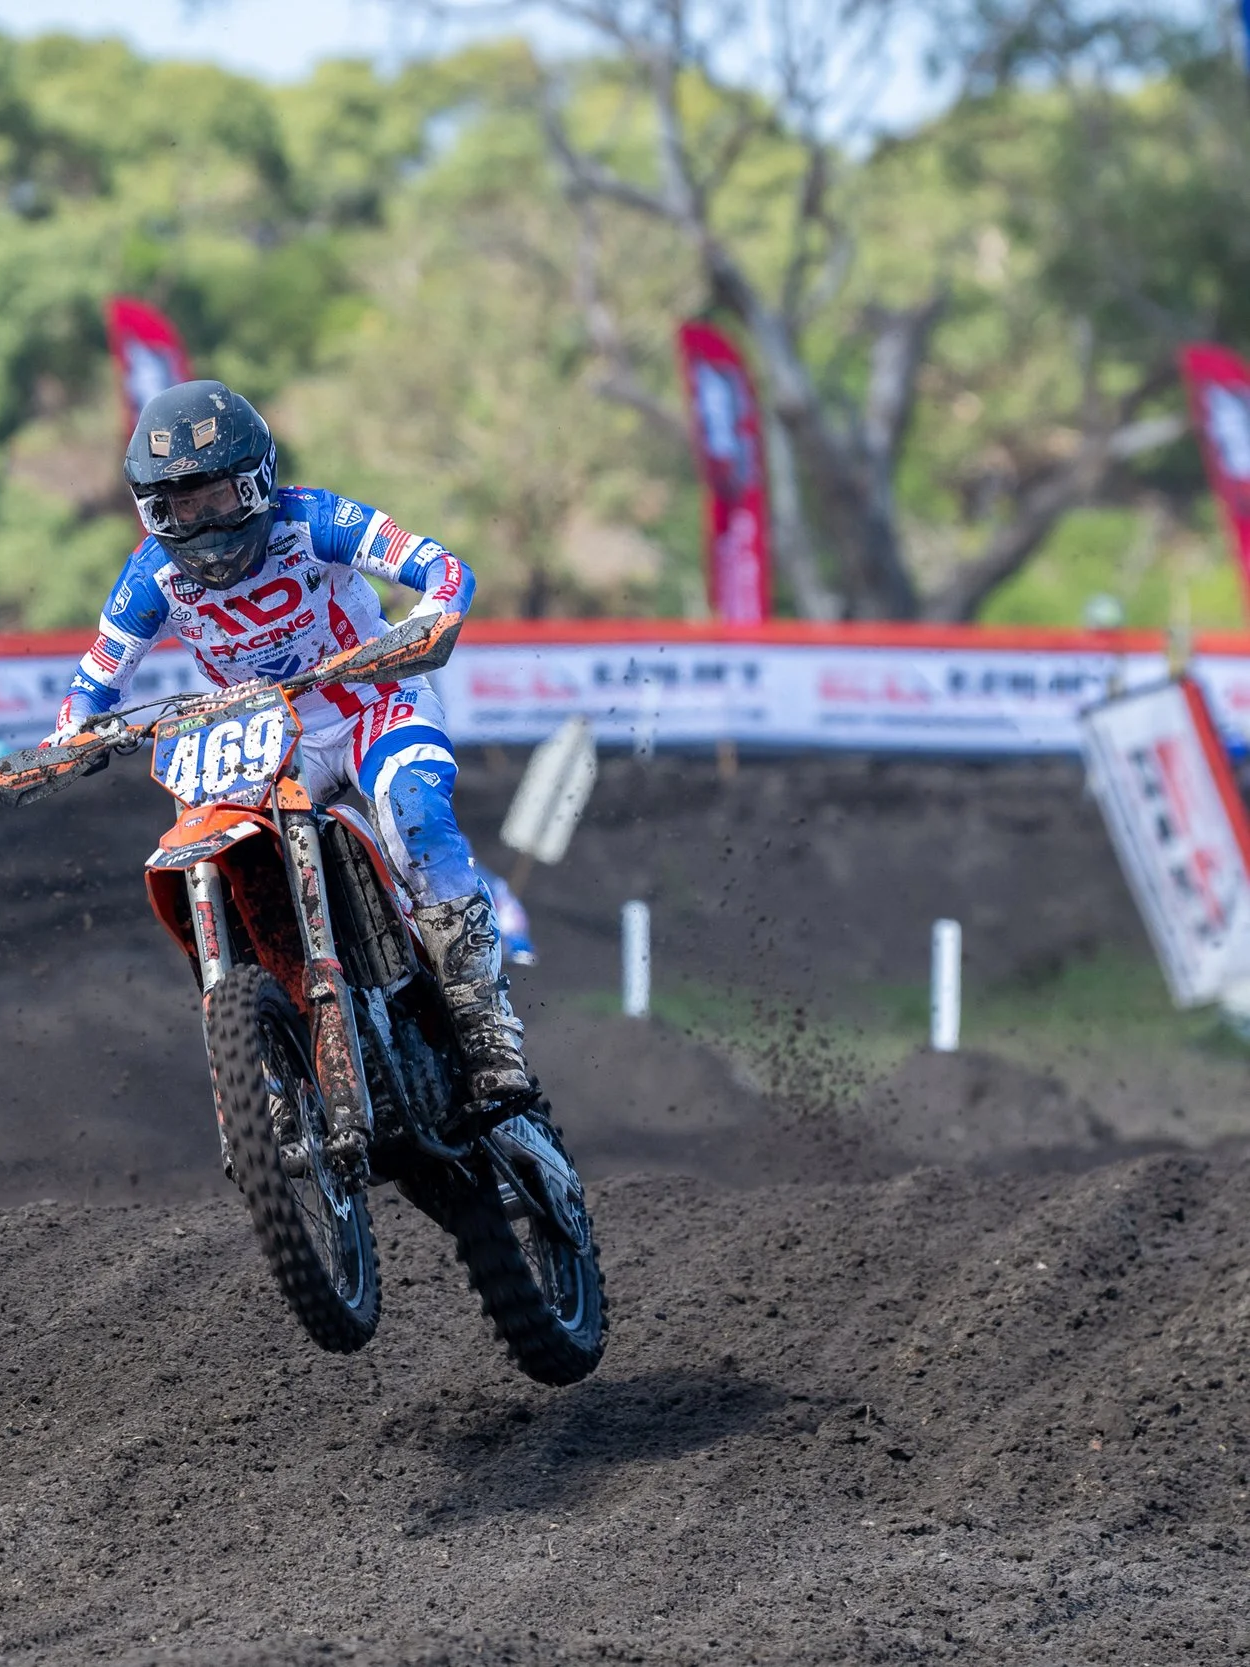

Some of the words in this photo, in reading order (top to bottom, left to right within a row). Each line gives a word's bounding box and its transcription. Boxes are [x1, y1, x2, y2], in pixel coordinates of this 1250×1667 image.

[337, 502, 354, 524] USA
[174, 582, 203, 595] USA
[210, 609, 316, 657] RACING
[165, 709, 284, 801] 469
